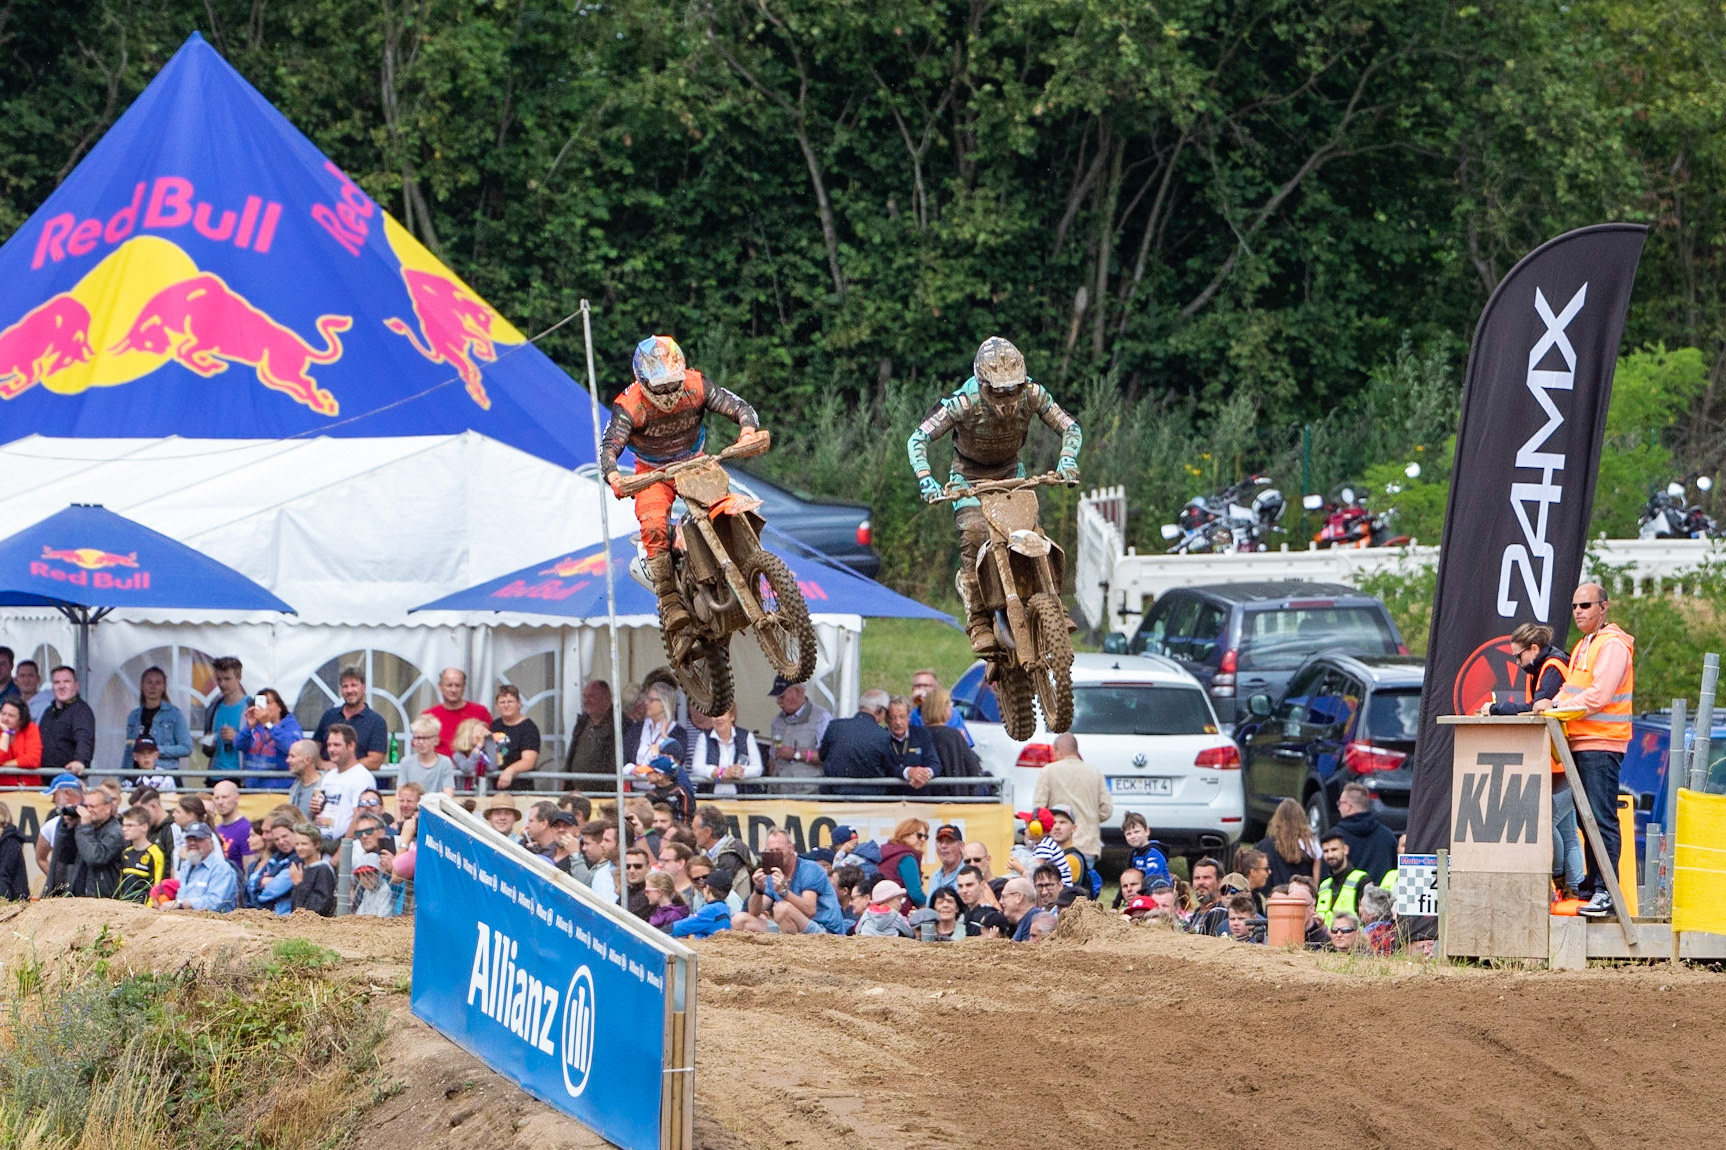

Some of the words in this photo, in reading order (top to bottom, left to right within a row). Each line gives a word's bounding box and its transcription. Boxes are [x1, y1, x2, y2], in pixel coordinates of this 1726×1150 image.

[30, 182, 147, 270] Red
[143, 176, 282, 254] Bull
[311, 160, 373, 257] Red
[30, 561, 87, 587] Red
[93, 571, 150, 590] Bull
[1116, 779, 1137, 790] ECK
[1144, 779, 1159, 791] HT
[1161, 780, 1168, 791] 4
[1454, 752, 1542, 844] KTM
[467, 921, 559, 1056] Allianz
